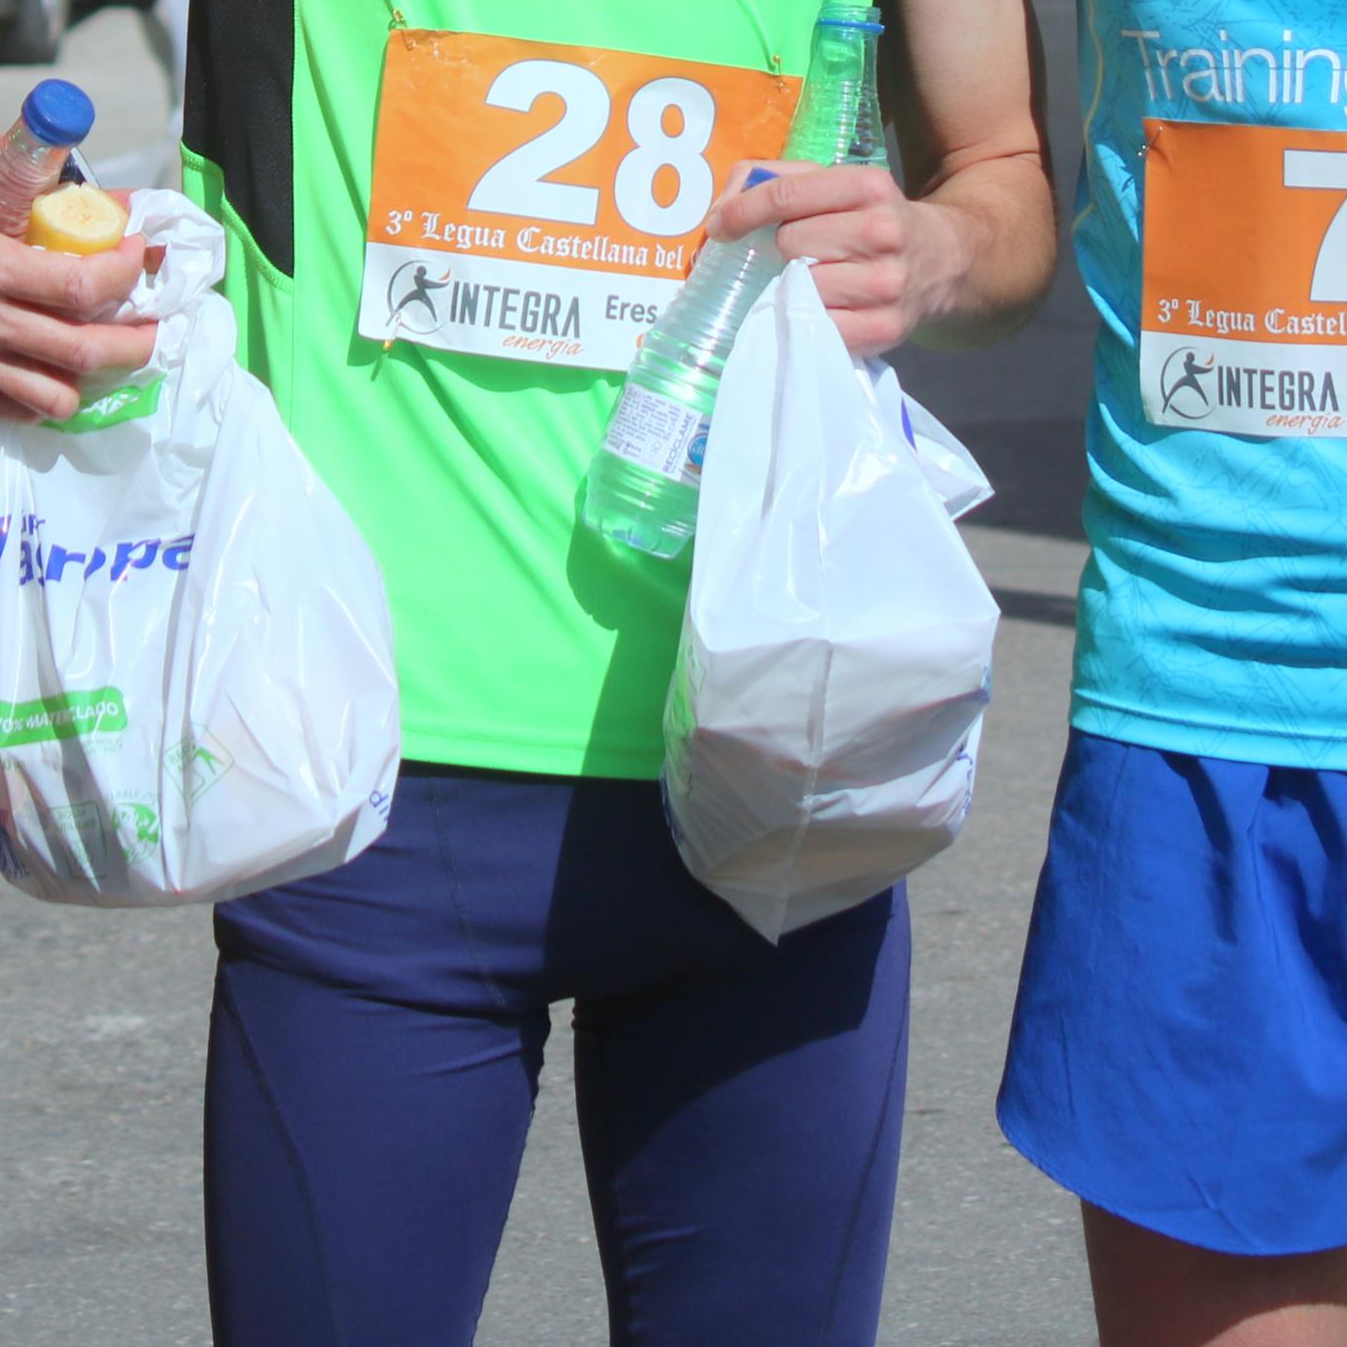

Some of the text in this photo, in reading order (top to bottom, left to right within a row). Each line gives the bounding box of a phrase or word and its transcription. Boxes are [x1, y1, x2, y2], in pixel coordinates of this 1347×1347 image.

[466, 58, 717, 237] 28
[420, 211, 507, 250] Legua
[516, 226, 649, 269] Castellana
[655, 243, 685, 270] del
[449, 280, 582, 339] INTEGRA
[605, 294, 658, 325] Eres
[1187, 300, 1256, 334] Legua
[1217, 364, 1340, 413] INTEGRA
